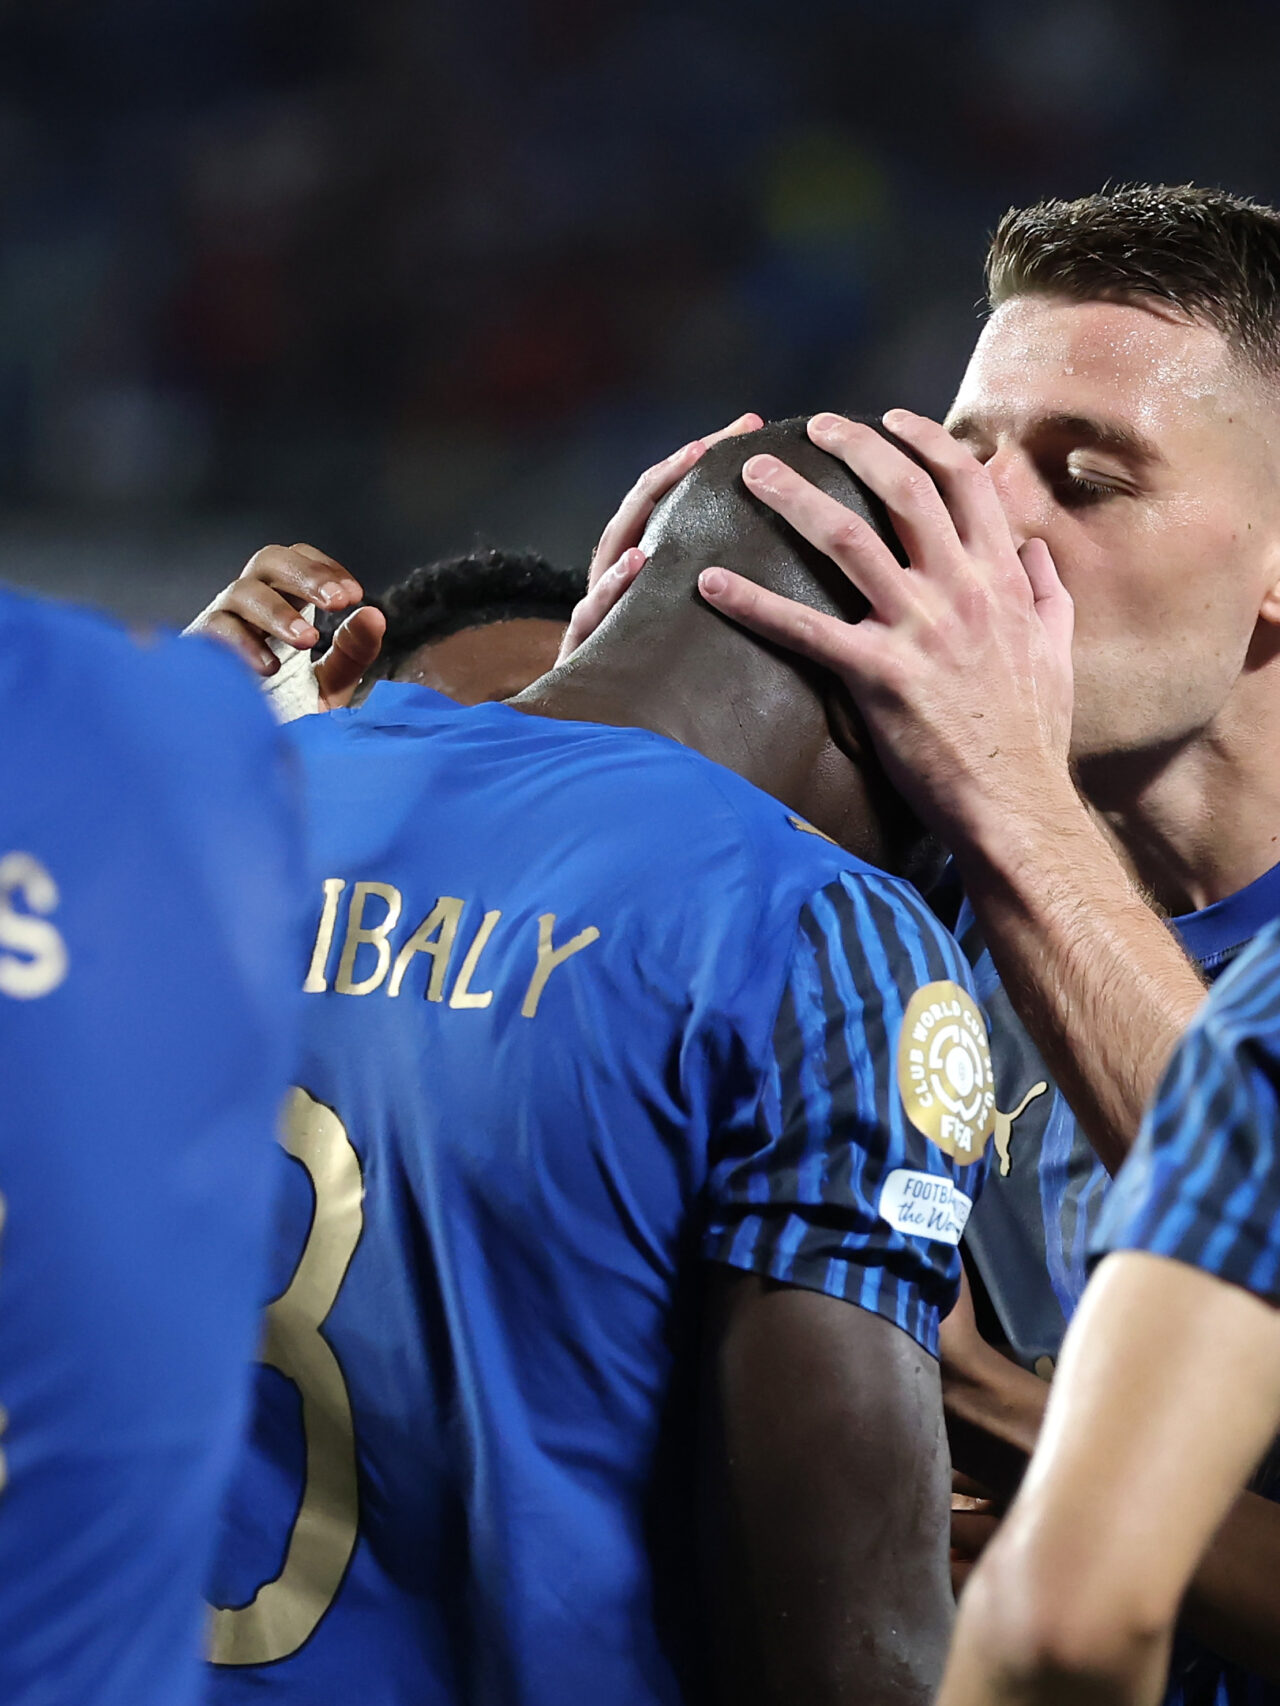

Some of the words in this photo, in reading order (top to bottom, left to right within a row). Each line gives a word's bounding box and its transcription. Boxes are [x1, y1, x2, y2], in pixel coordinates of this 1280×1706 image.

[0, 852, 68, 998] S
[303, 878, 600, 1018] IBALY
[912, 1000, 962, 1043] WORLD
[963, 1009, 986, 1047] CUP
[910, 1048, 933, 1108] CLUB
[896, 1201, 925, 1224] the
